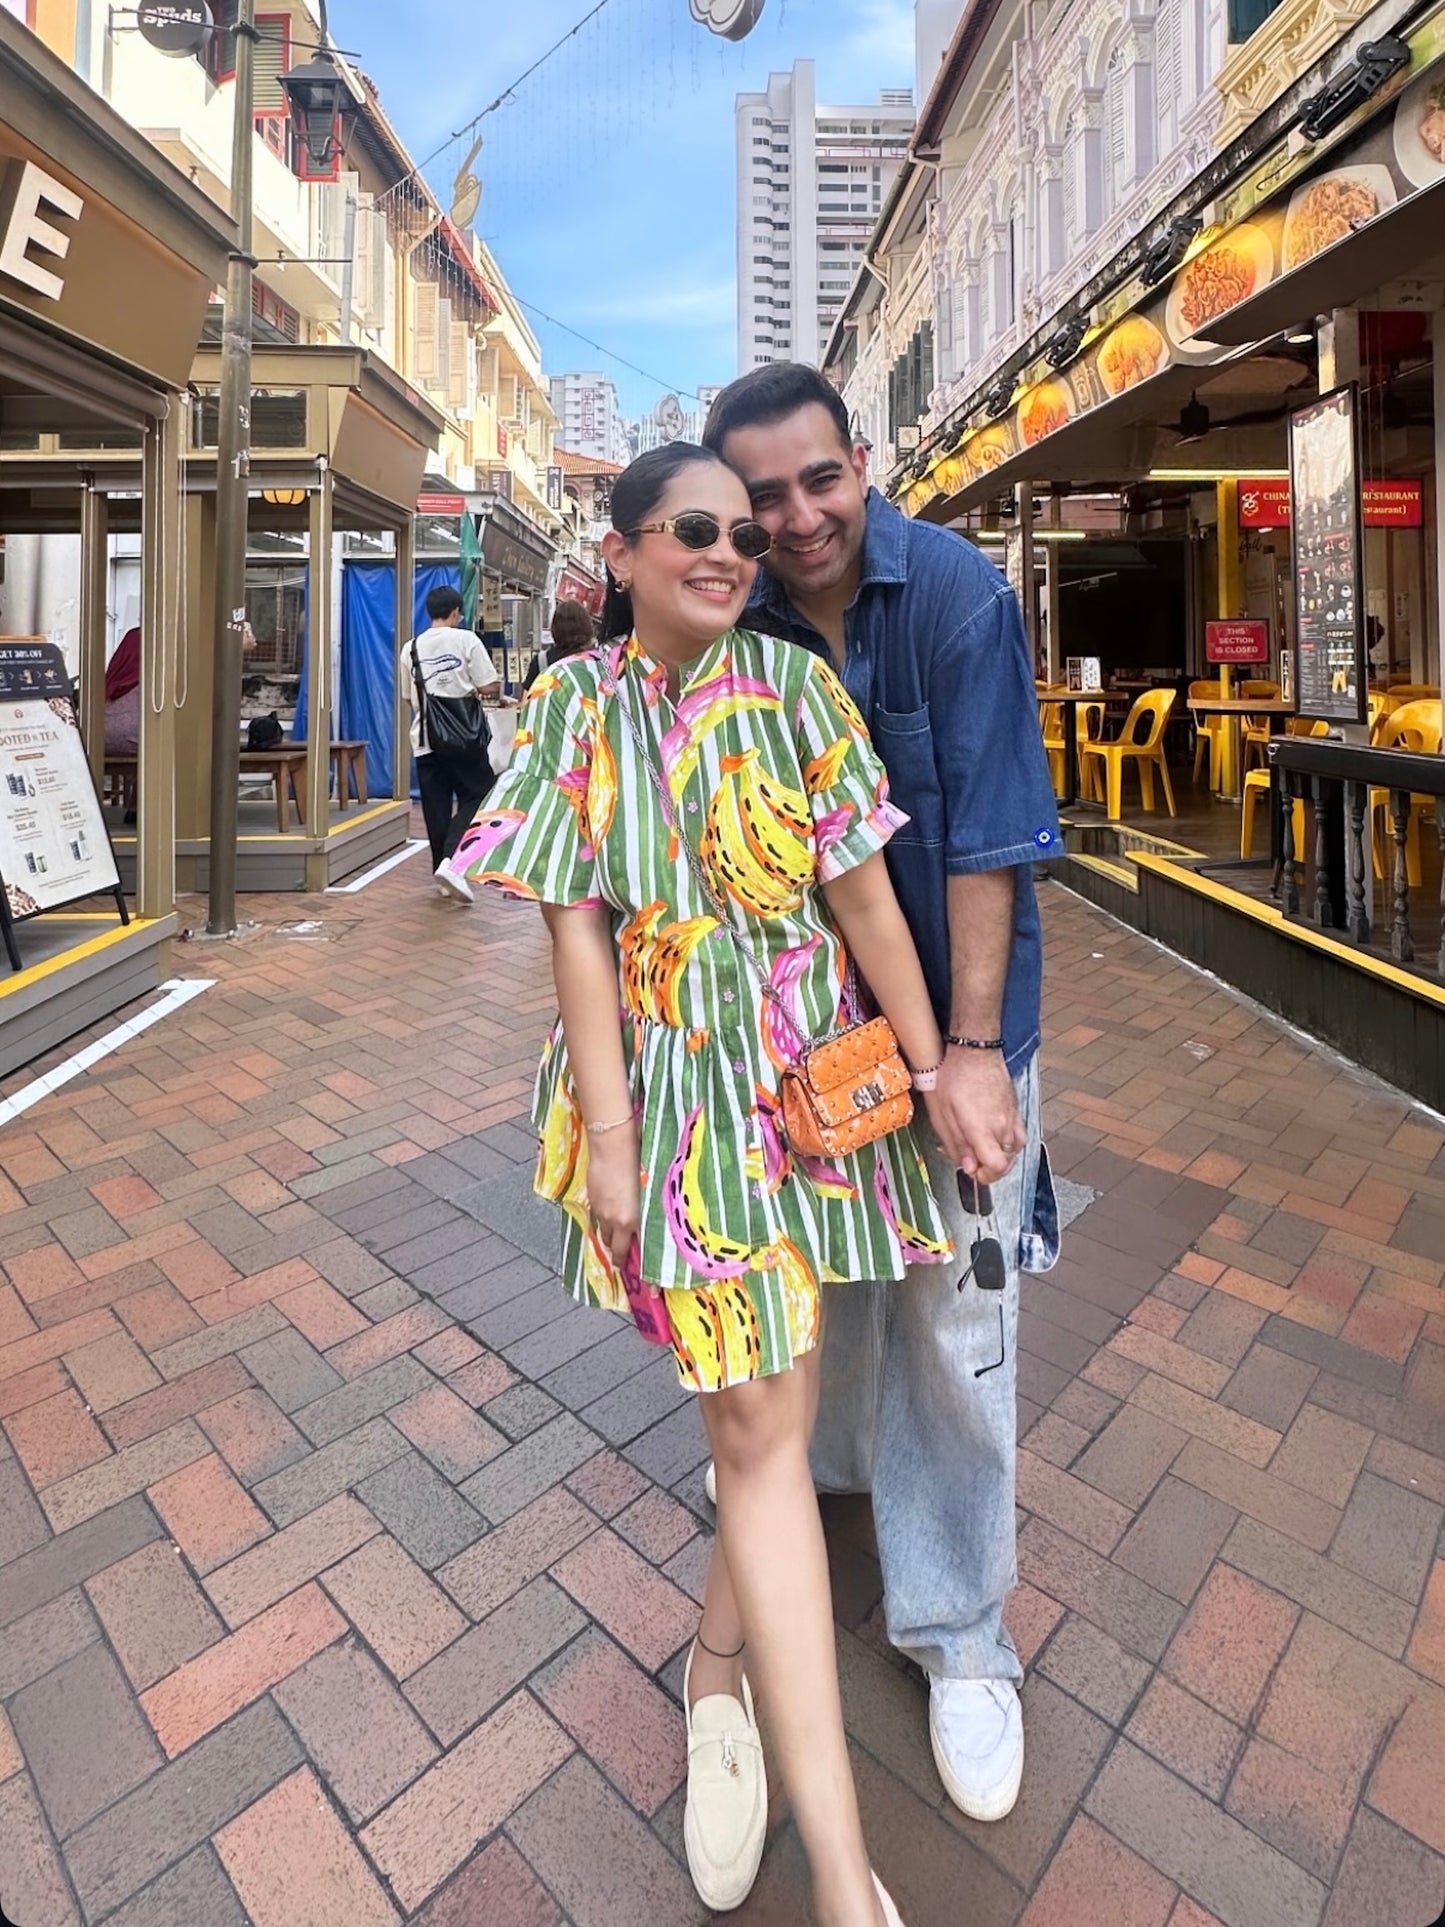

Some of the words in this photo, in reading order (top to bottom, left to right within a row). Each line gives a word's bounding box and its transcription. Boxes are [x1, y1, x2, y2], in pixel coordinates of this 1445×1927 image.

[156, 6, 176, 14] TWO
[143, 8, 202, 27] Spuds
[0, 158, 84, 302] E
[1218, 636, 1255, 645] SECTION
[1214, 646, 1224, 654] IS
[1224, 646, 1259, 654] CLOSED
[39, 730, 60, 742] TEA
